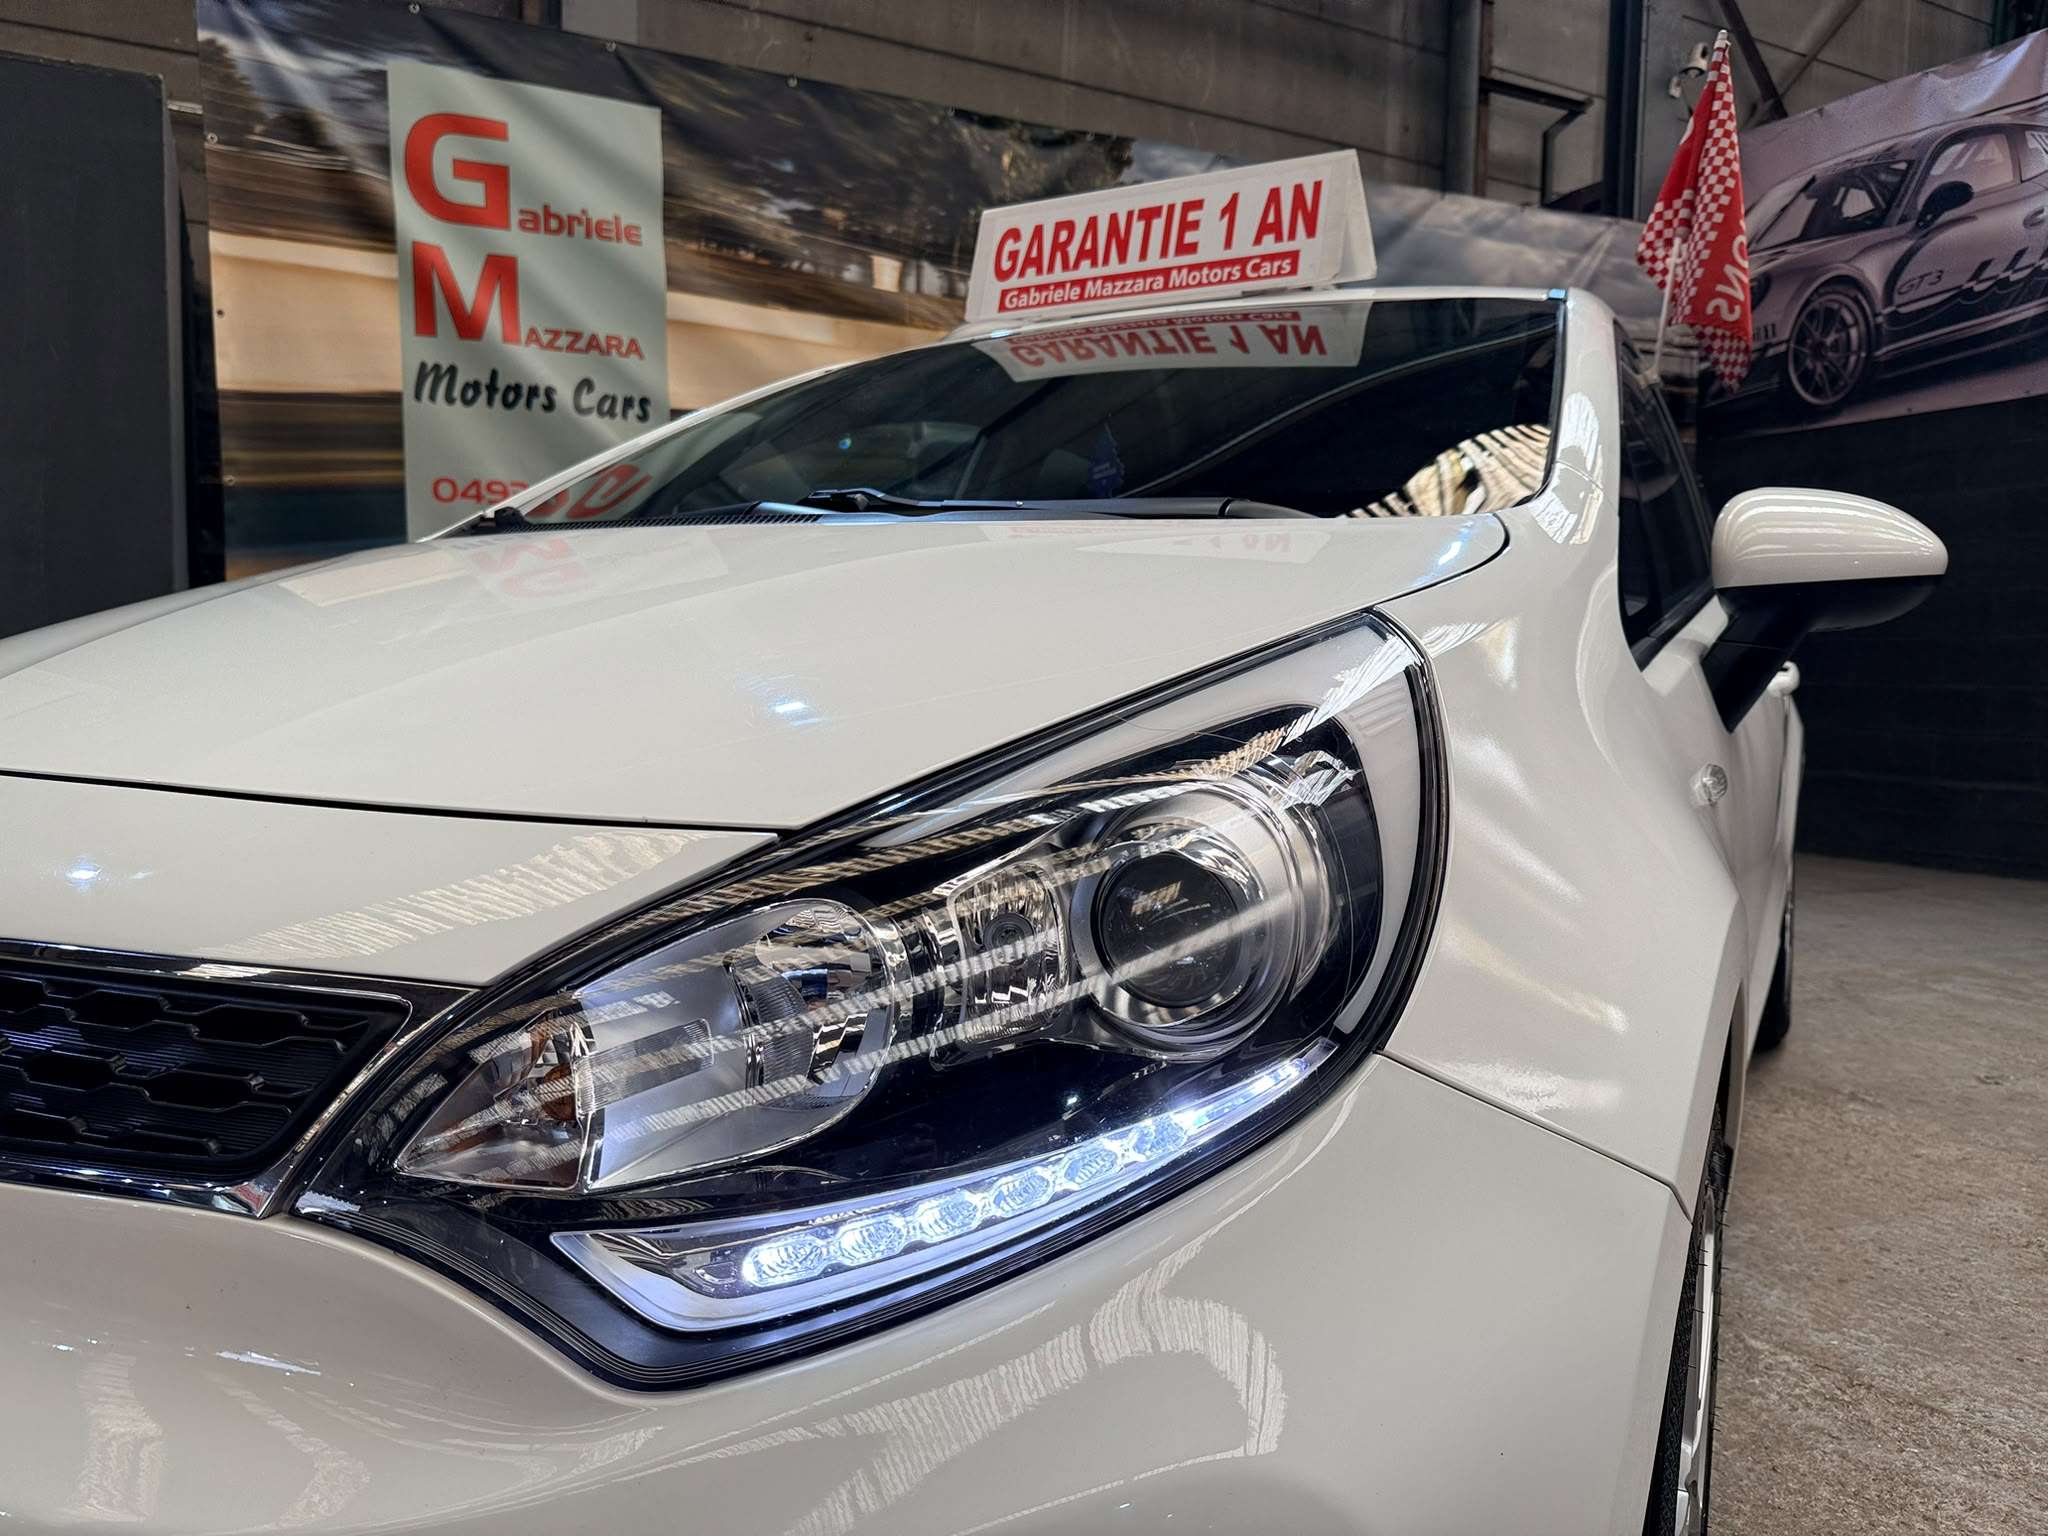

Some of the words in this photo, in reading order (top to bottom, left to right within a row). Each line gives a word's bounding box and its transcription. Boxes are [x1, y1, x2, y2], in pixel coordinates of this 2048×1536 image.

[993, 198, 1205, 283] GARANTIE
[1218, 192, 1240, 251] 1
[1252, 179, 1323, 247] AN
[1004, 287, 1080, 311] Gabriele
[1084, 275, 1164, 300] Mazzara
[1168, 265, 1242, 289] Motors
[1246, 257, 1293, 279] Cars
[1897, 269, 1944, 295] GT3
[414, 360, 557, 413] Motors
[573, 377, 651, 423] Cars
